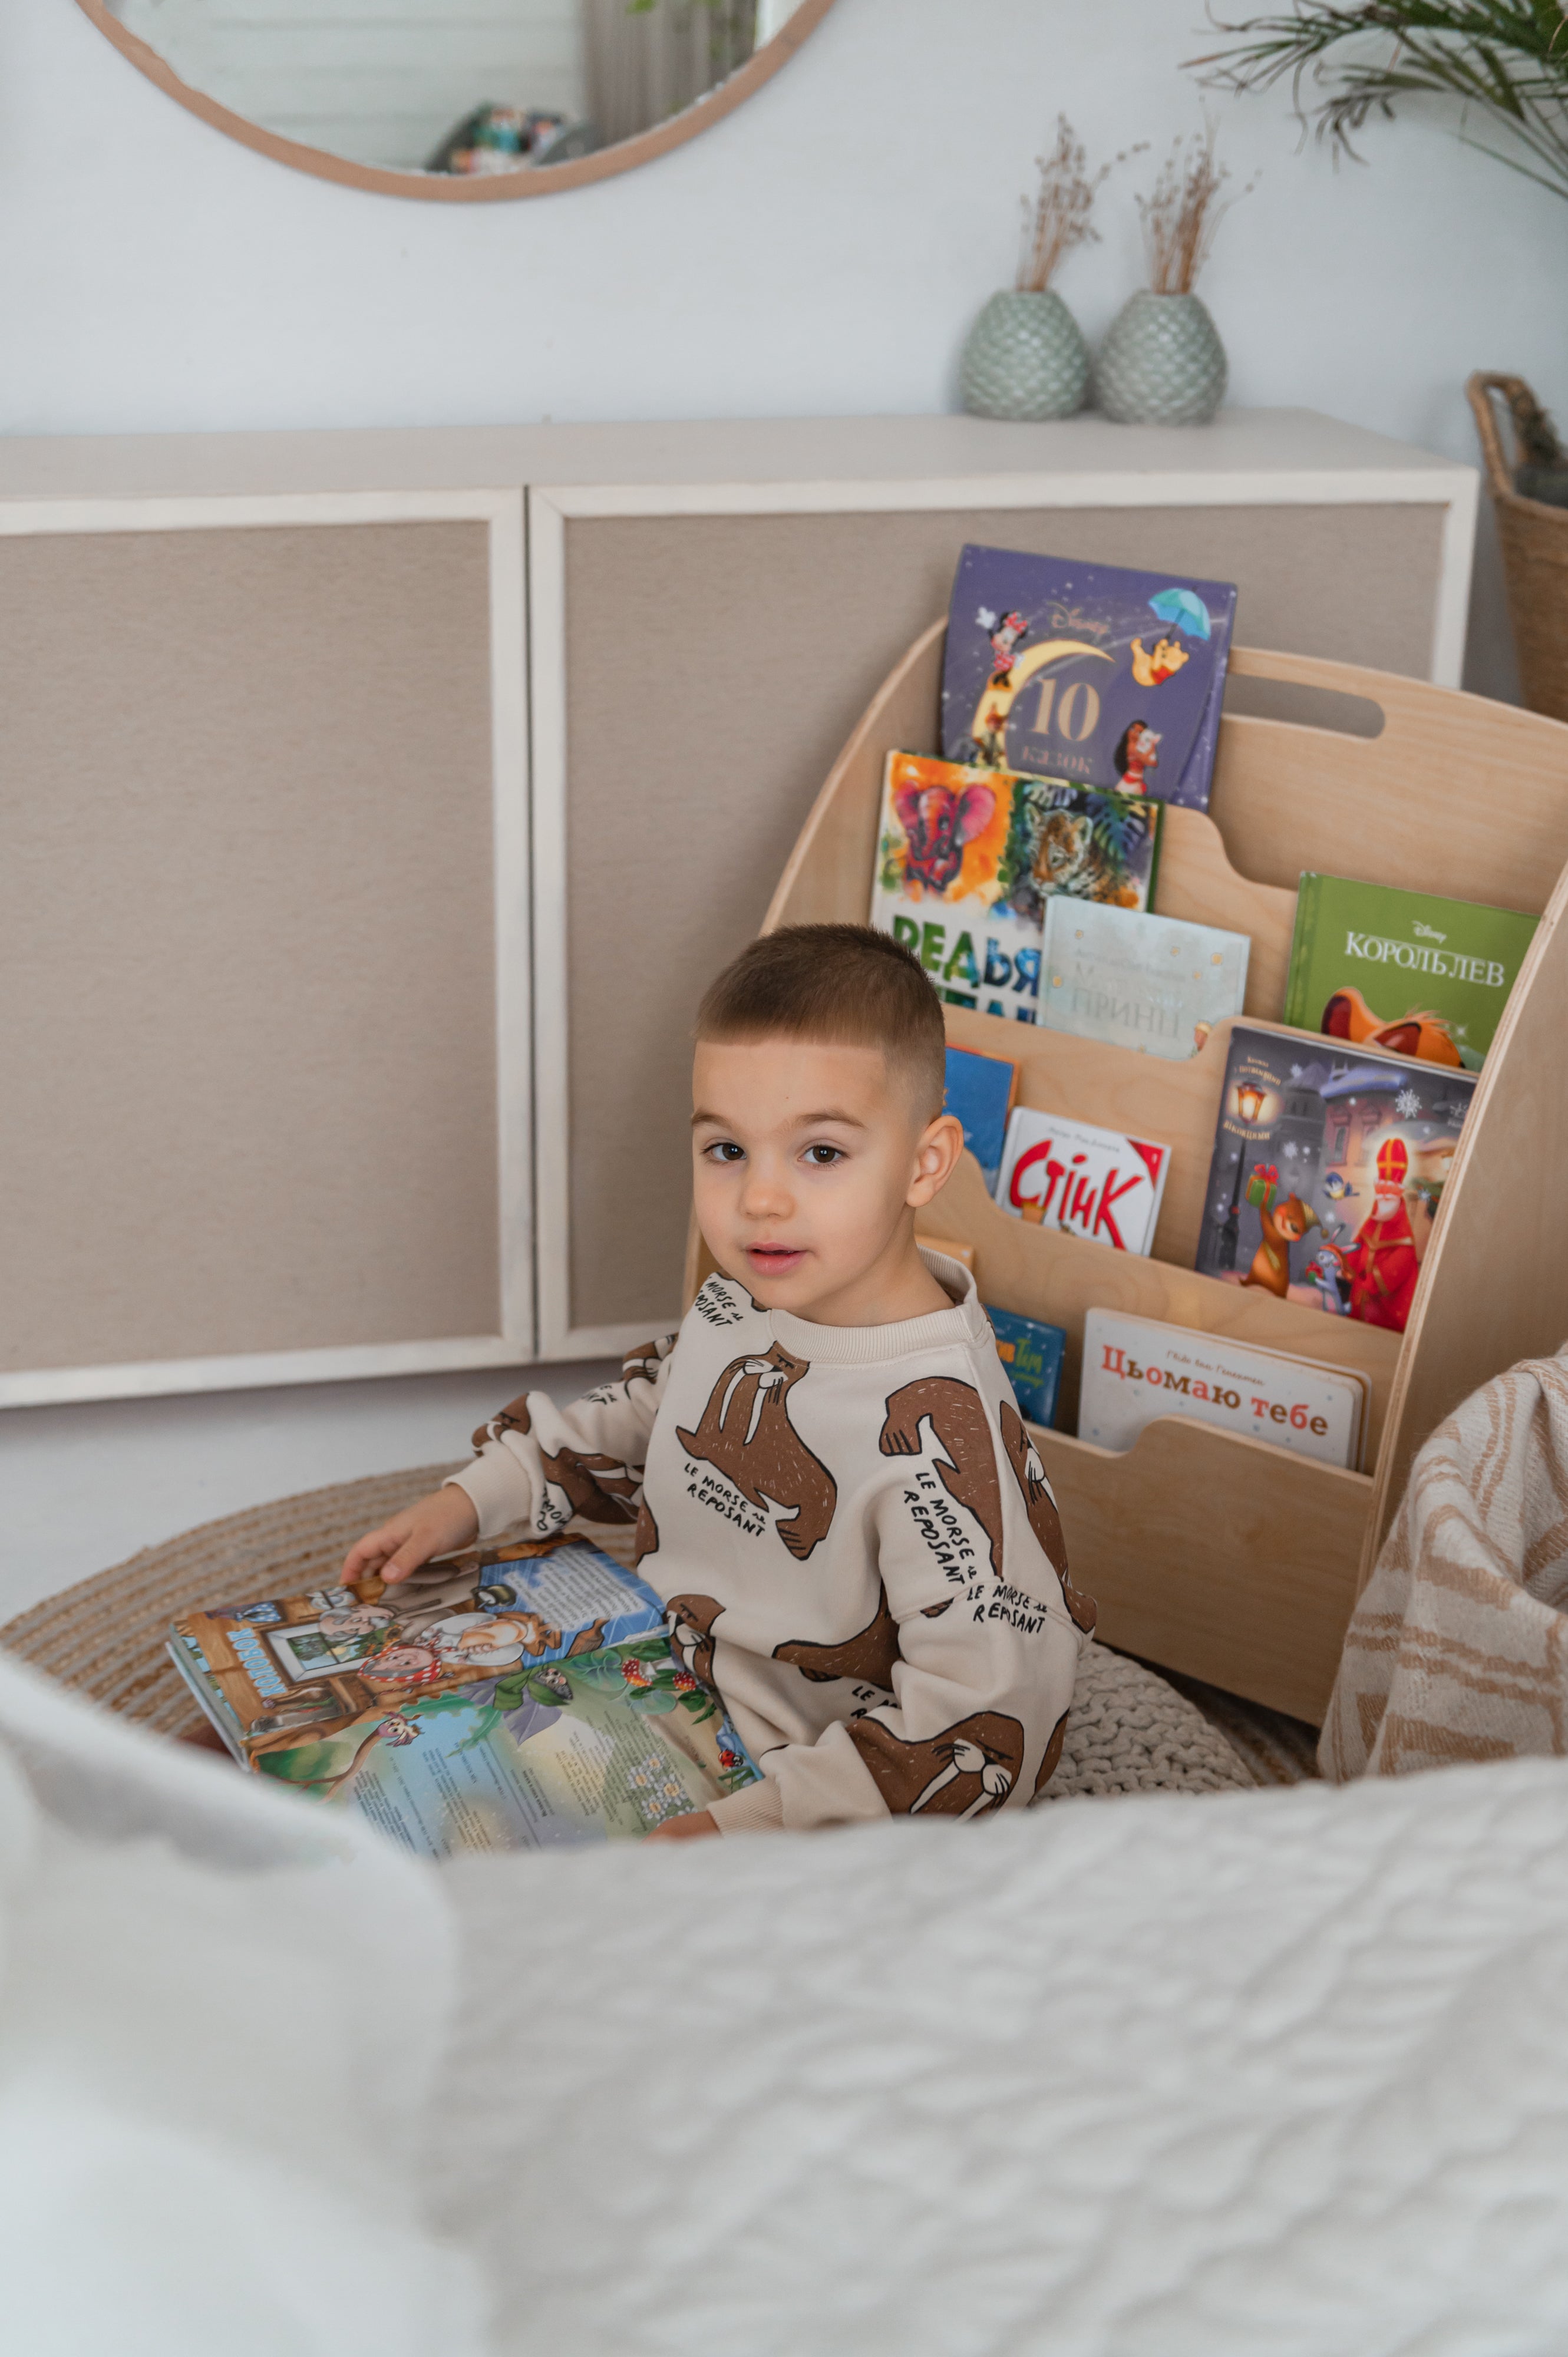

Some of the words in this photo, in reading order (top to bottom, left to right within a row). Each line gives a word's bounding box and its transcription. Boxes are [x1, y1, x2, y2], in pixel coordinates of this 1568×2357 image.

[1047, 601, 1109, 643] Disney
[1032, 678, 1100, 741] 10
[1412, 920, 1447, 943] Disney
[1345, 931, 1447, 975] КОРОЛЬ
[1448, 955, 1505, 988] ЛЕВ
[705, 1282, 737, 1309] MORSE
[1101, 1344, 1241, 1409] Цьомаю
[1251, 1396, 1328, 1436] тебе
[684, 1463, 698, 1477] LE
[702, 1475, 748, 1513] MORSE
[687, 1483, 765, 1537] REPOSANT
[904, 1490, 965, 1584] REPOSANT
[916, 1473, 936, 1490] LE
[930, 1499, 975, 1560] MORSE
[967, 1585, 984, 1601] LE
[992, 1585, 1031, 1609] MORSE
[973, 1602, 1045, 1633] REPOSANT
[226, 1628, 288, 1698] КОЛОБОК
[851, 1686, 875, 1701] LE
